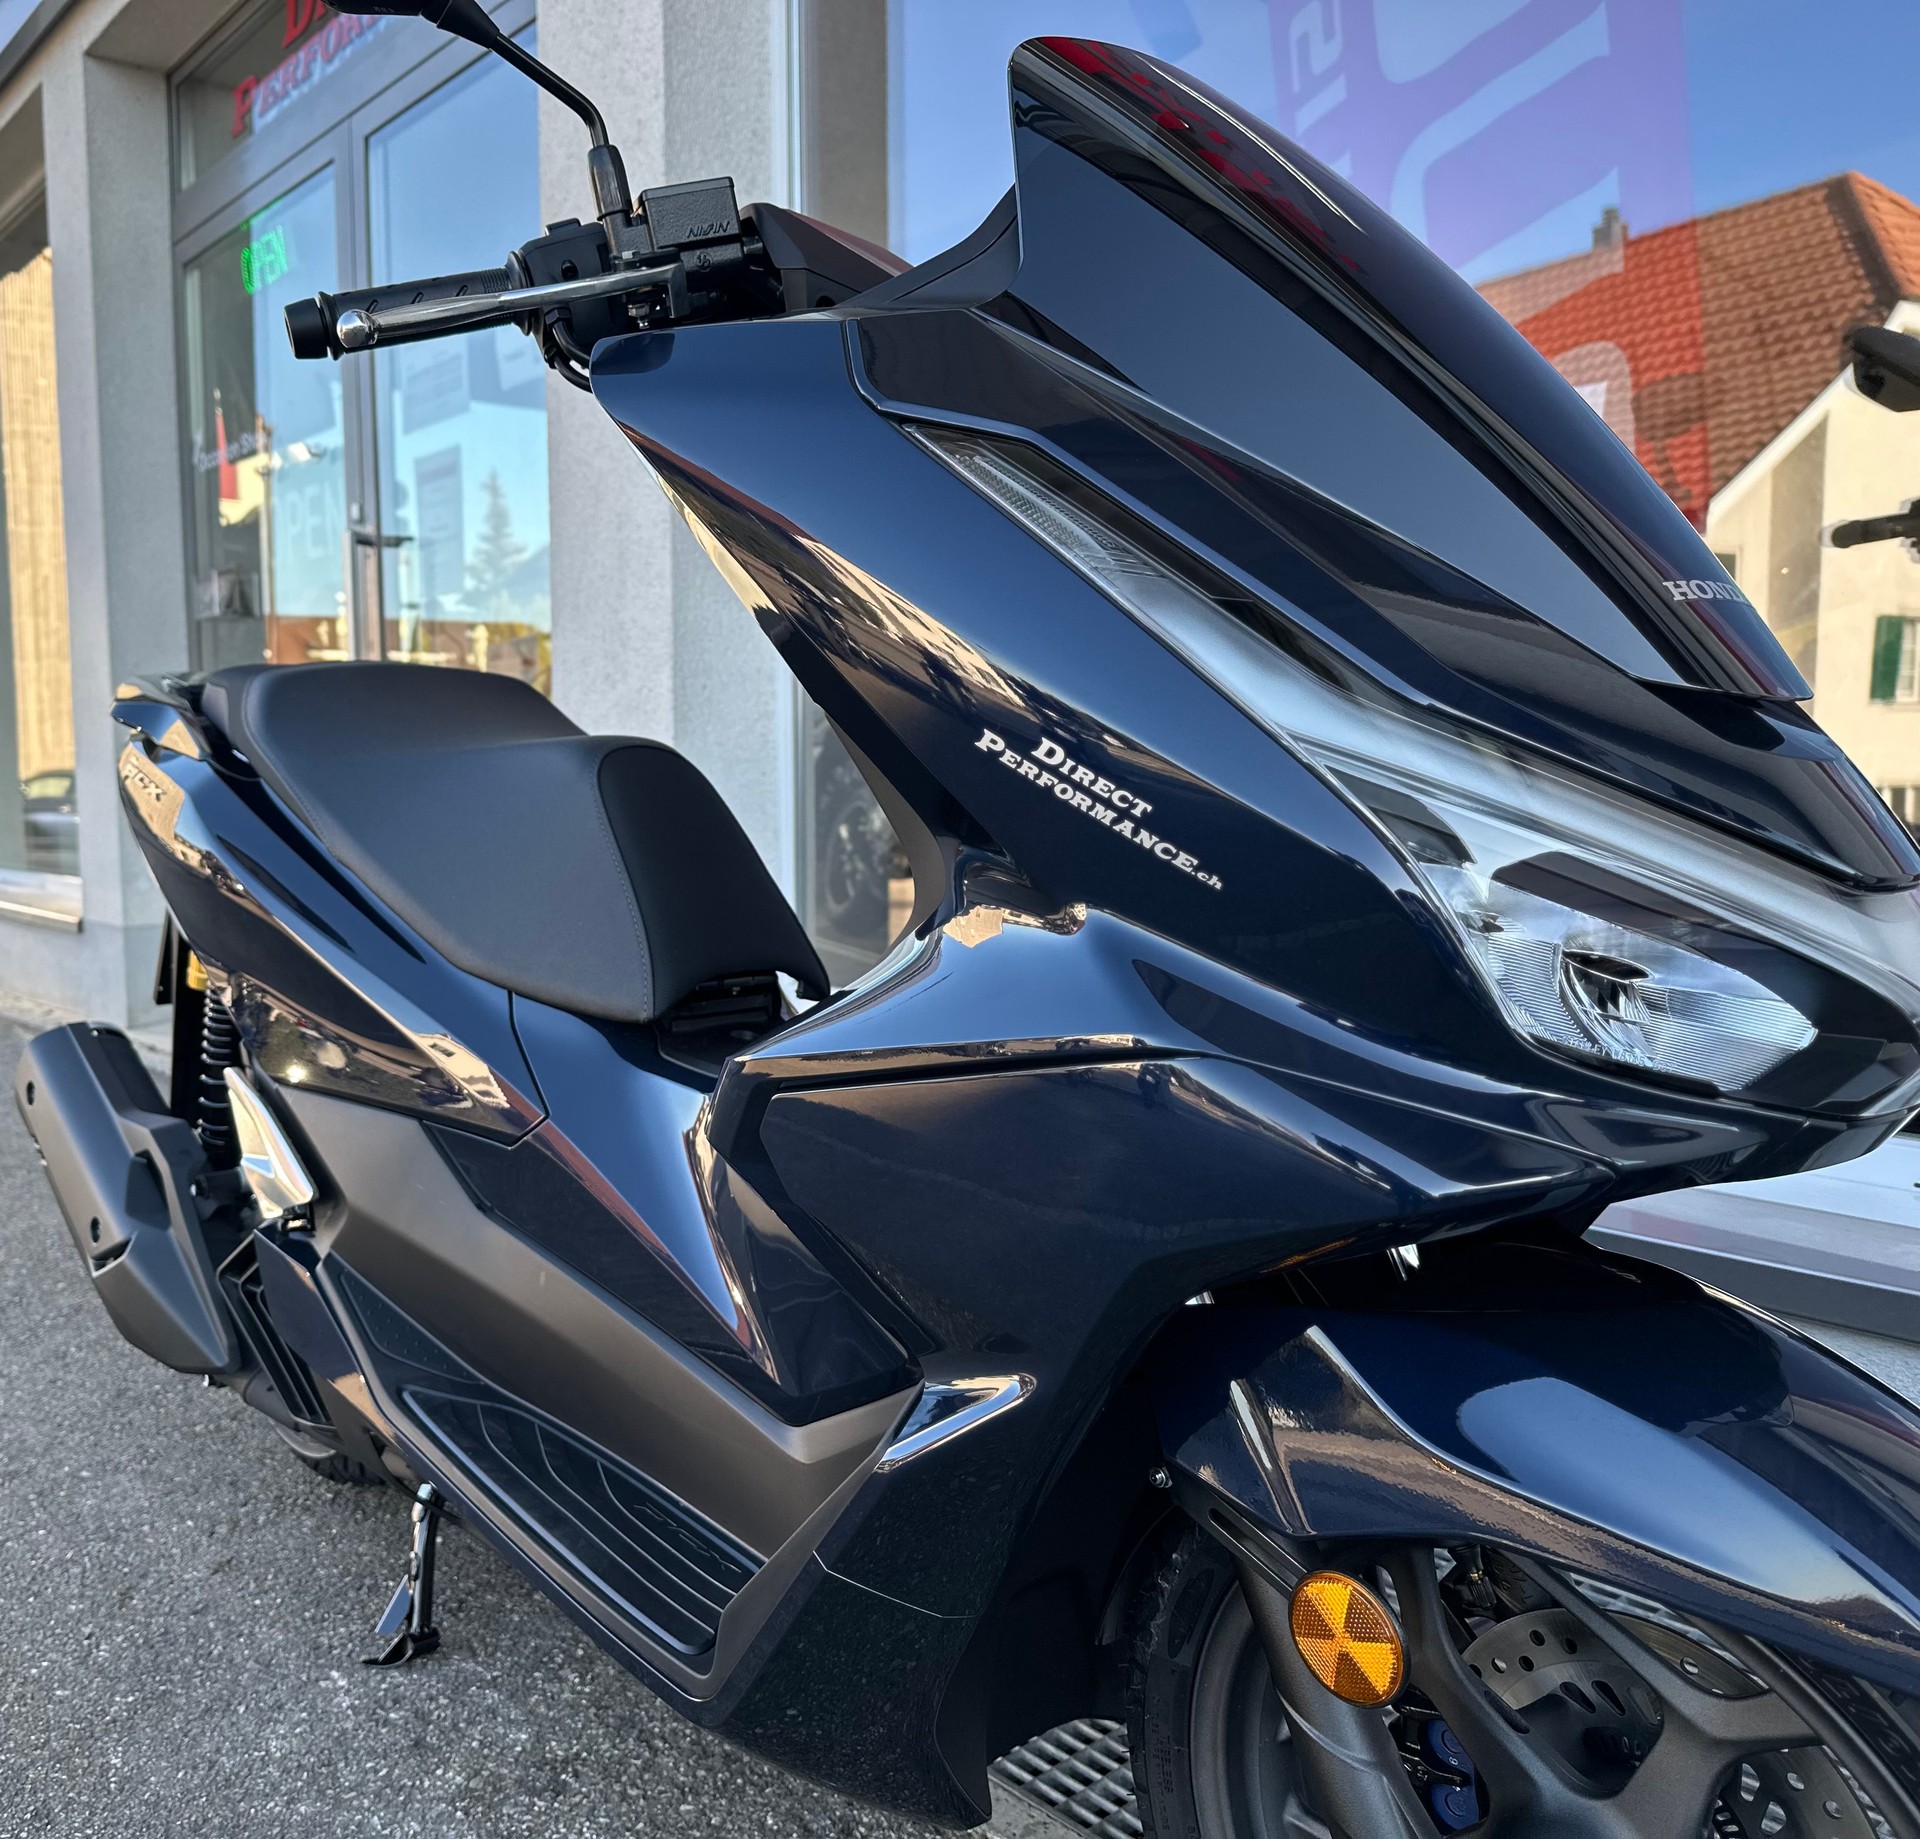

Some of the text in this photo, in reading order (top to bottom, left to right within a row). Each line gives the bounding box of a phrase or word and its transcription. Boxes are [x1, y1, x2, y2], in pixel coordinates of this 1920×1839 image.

[241, 226, 289, 294] OPEN
[1662, 579, 1748, 603] HOND
[974, 729, 1223, 890] PERFORMANCE.ch
[1031, 737, 1152, 817] DIRECT
